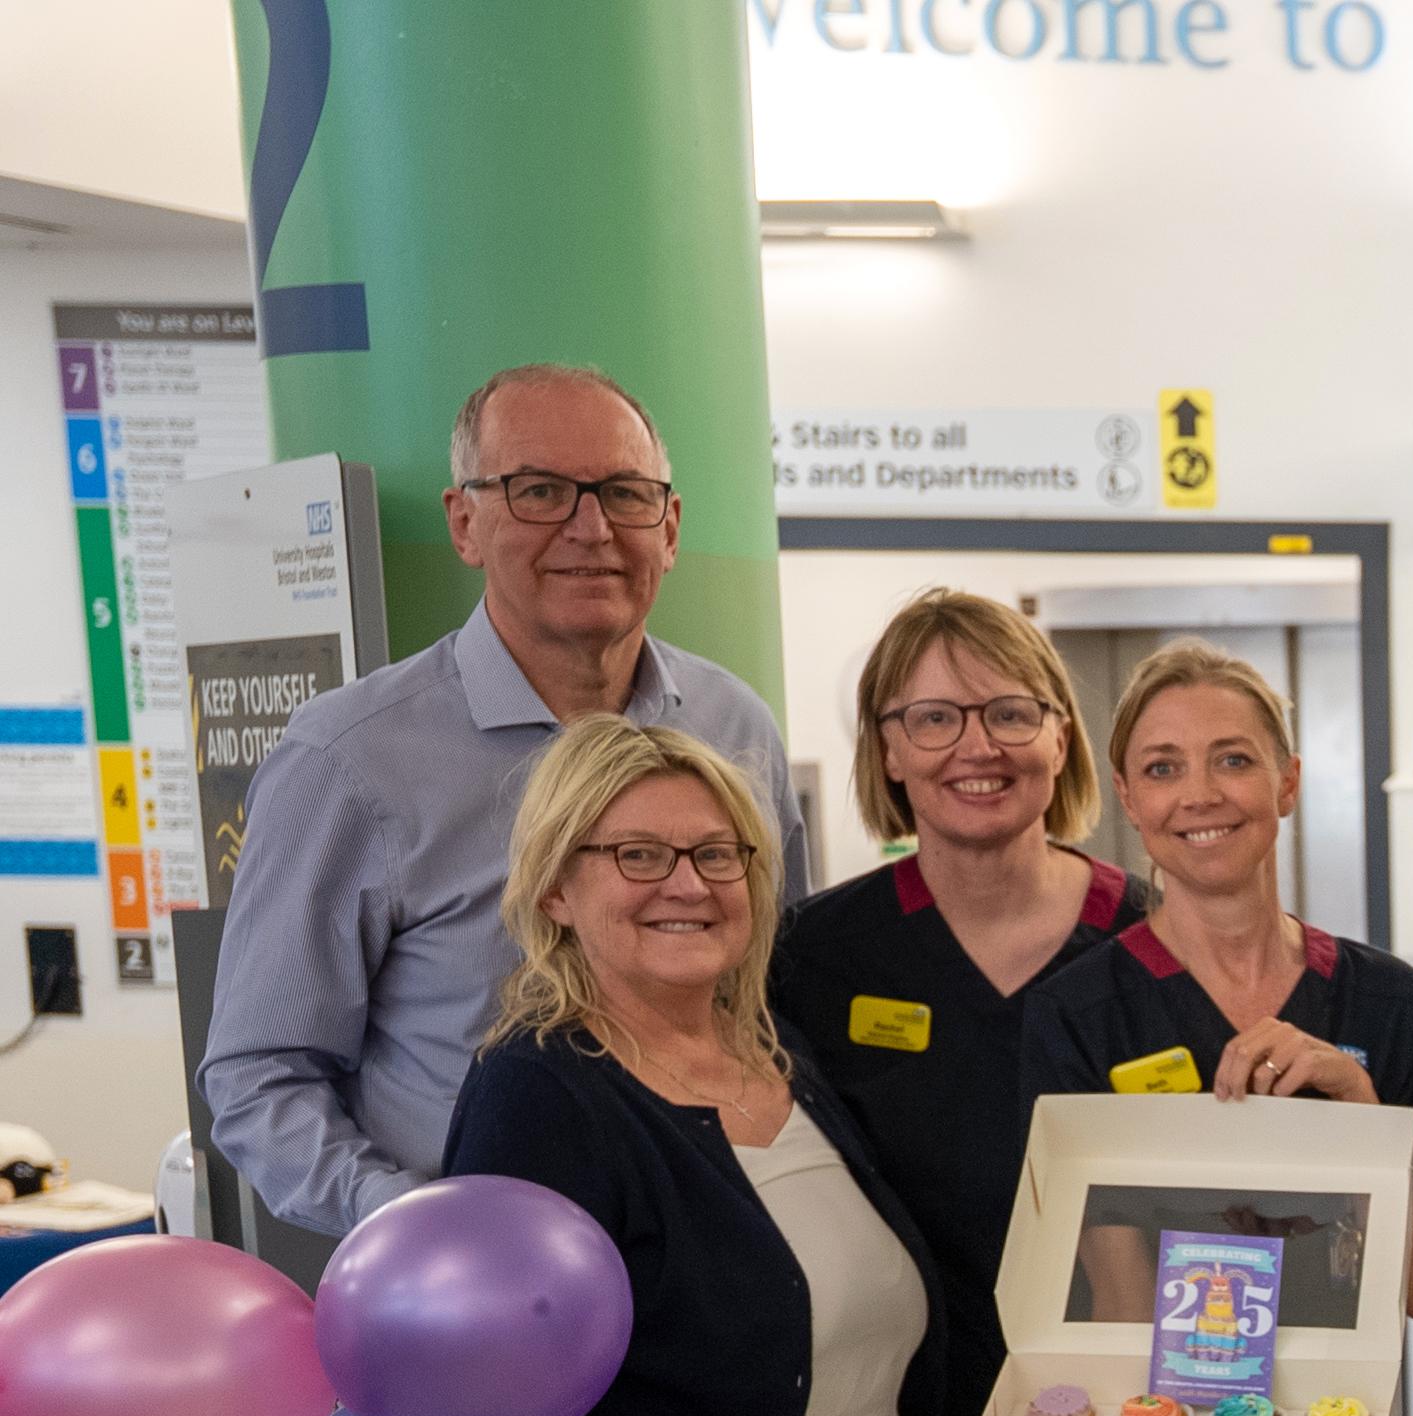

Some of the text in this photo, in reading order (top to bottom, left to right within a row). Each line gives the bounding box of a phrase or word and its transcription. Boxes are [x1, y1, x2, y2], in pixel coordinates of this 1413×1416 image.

[1281, 0, 1386, 71] to
[68, 362, 88, 394] 7
[790, 421, 968, 450] Stairs to all
[77, 442, 97, 475] 6
[808, 461, 865, 487] and
[877, 462, 1079, 492] Departments
[92, 597, 112, 629] 5
[202, 677, 237, 717] KEEP
[207, 727, 239, 767] AND
[111, 783, 127, 810] 4
[119, 875, 138, 906] 3
[125, 939, 145, 971] 2
[1181, 1247, 1262, 1263] CELEBRATING
